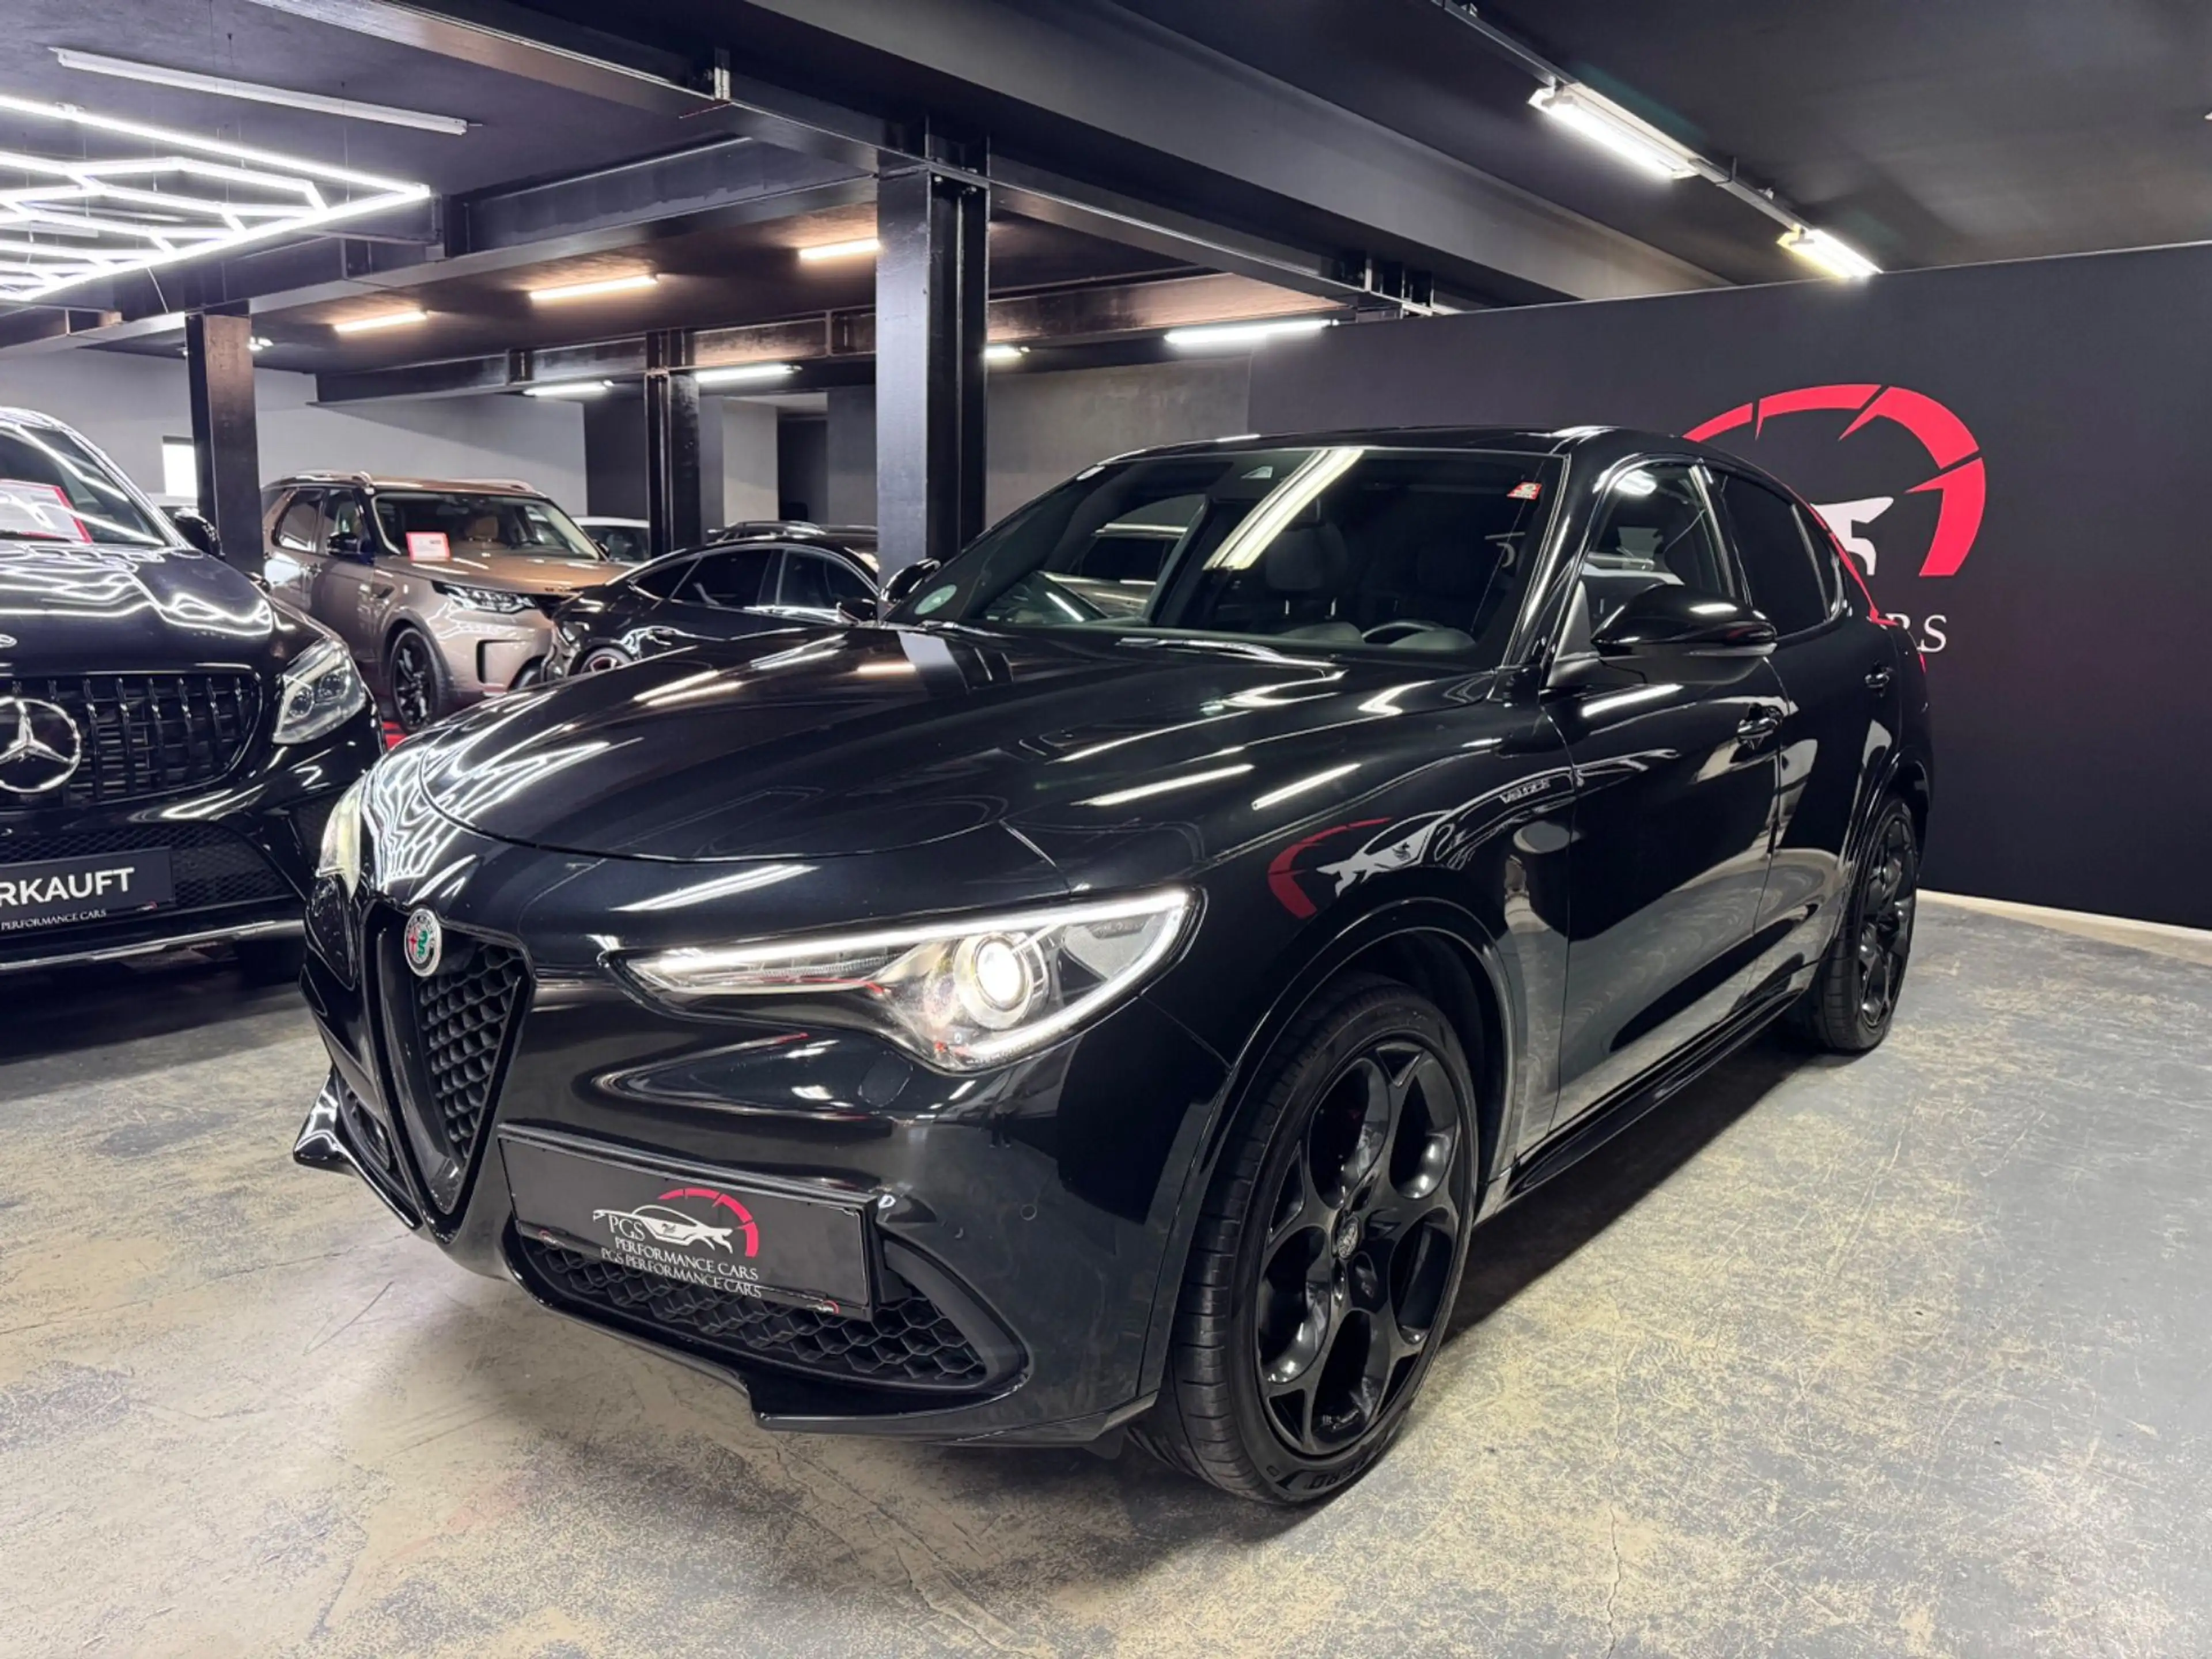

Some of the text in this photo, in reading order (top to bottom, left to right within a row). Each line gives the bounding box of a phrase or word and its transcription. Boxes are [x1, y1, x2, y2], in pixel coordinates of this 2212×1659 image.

[1, 909, 107, 931] PERFORMANCE CARS
[608, 1214, 646, 1241] PGS
[601, 1247, 762, 1298] PGS PERFORMANCE CARS
[615, 1236, 759, 1281] PERFORMANCE CARS
